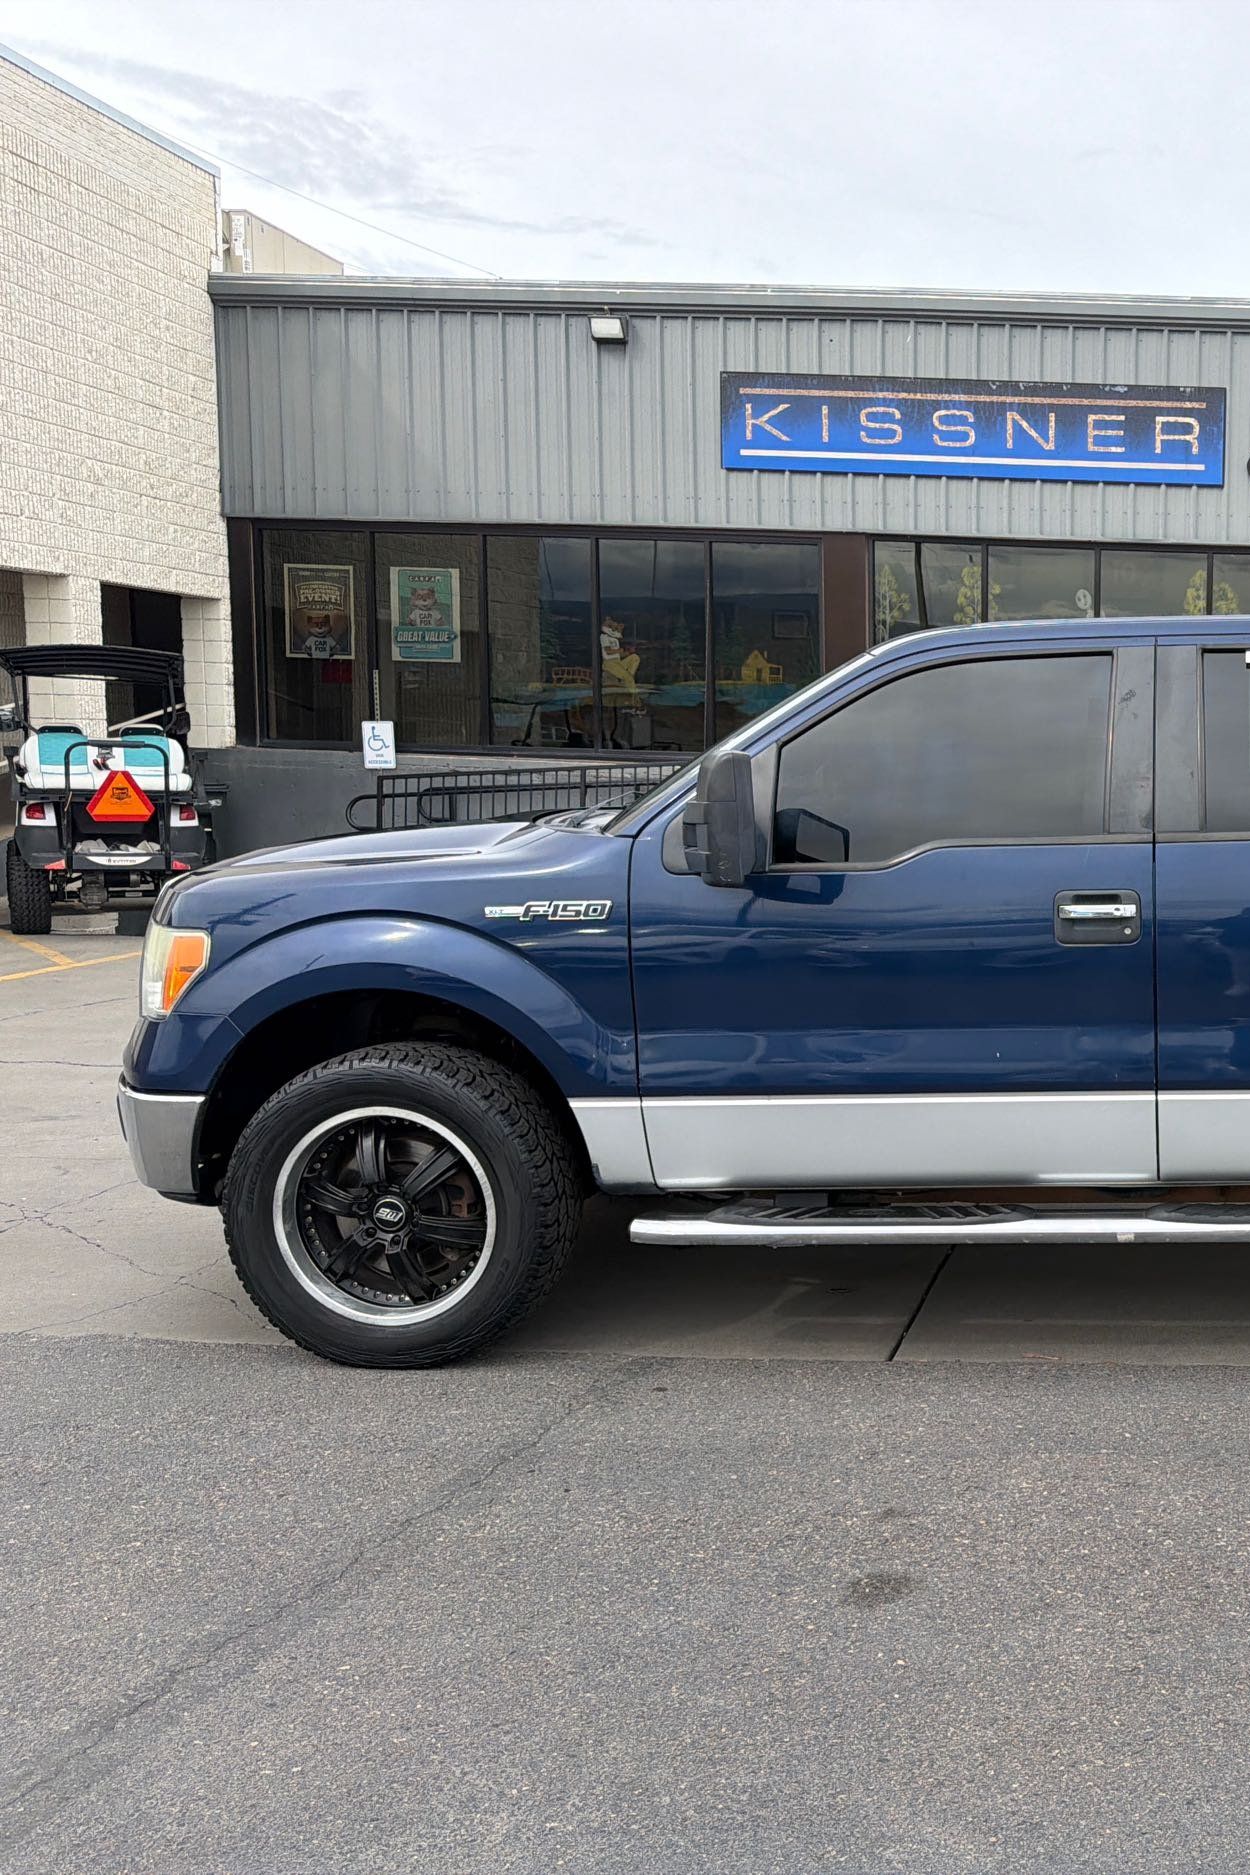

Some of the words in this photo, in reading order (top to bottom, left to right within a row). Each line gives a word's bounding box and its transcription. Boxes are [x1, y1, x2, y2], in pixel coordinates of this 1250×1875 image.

[745, 402, 1200, 455] KISSNER
[299, 593, 341, 604] EVENT!
[397, 631, 422, 642] GREAT
[425, 631, 449, 642] VALUE
[520, 900, 613, 921] F-150
